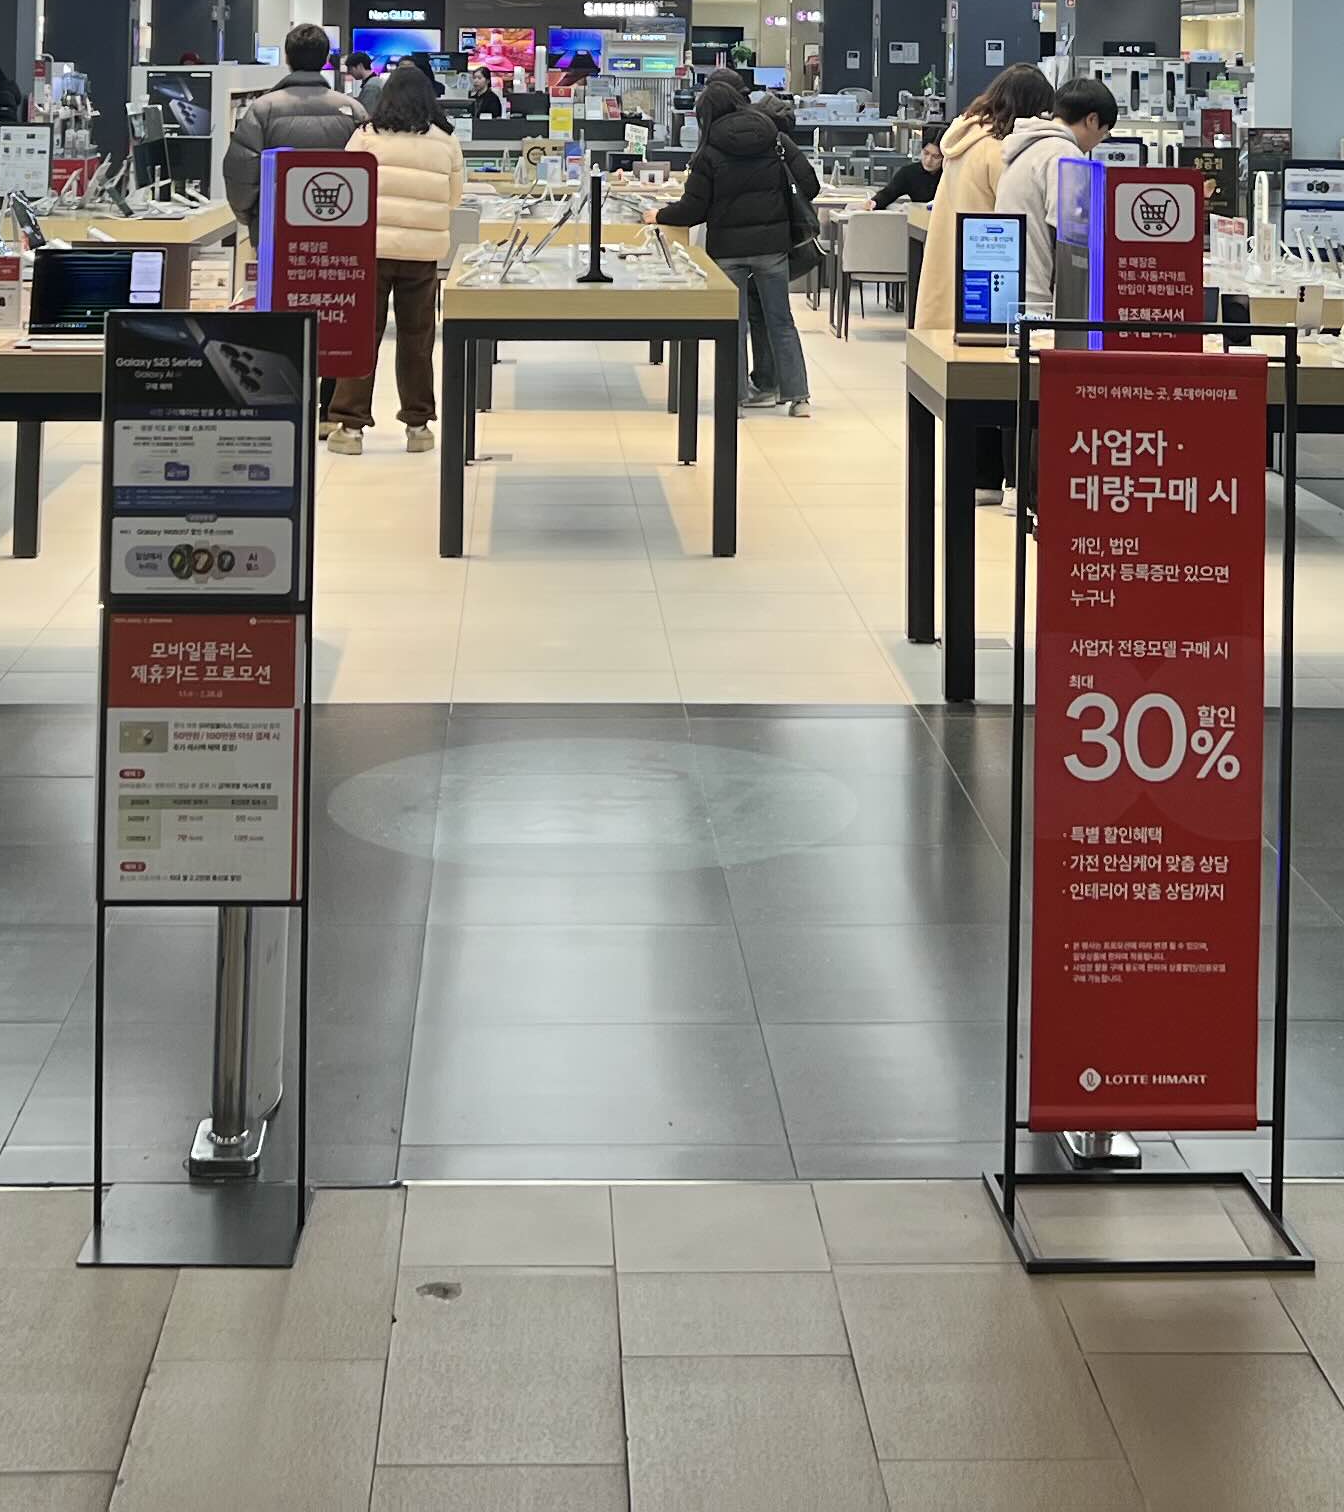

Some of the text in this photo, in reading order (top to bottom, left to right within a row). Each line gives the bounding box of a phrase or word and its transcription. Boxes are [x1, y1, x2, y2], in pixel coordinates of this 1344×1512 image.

[583, 2, 657, 17] SAMSUNG
[116, 357, 203, 369] Galaxy S25 Series
[1075, 385, 1238, 401] 가전이 쉬워지는 곳, 롯데하이마트
[1069, 428, 1168, 467] 사업자
[1069, 475, 1238, 515] 대량구매 시
[1071, 537, 1139, 557] 개인, 법인
[1071, 563, 1230, 584] 사업자 등록증만 있으면
[1071, 589, 1115, 607] 누구나
[150, 642, 253, 661] 모바일플러스
[1070, 639, 1229, 660] 사업자 전용모델 구매 시
[131, 664, 272, 685] 제휴카드 프로모션
[1069, 675, 1094, 689] 최대
[1197, 706, 1236, 728] 할인
[1063, 692, 1241, 782] 30%
[1071, 826, 1163, 844] 특별 할인혜택
[1070, 854, 1229, 874] 가전 안심케어 맞춤 상담
[1070, 882, 1224, 901] 인테리어 맞춤 상담까지
[1105, 1074, 1208, 1085] LOTTE HIMART
